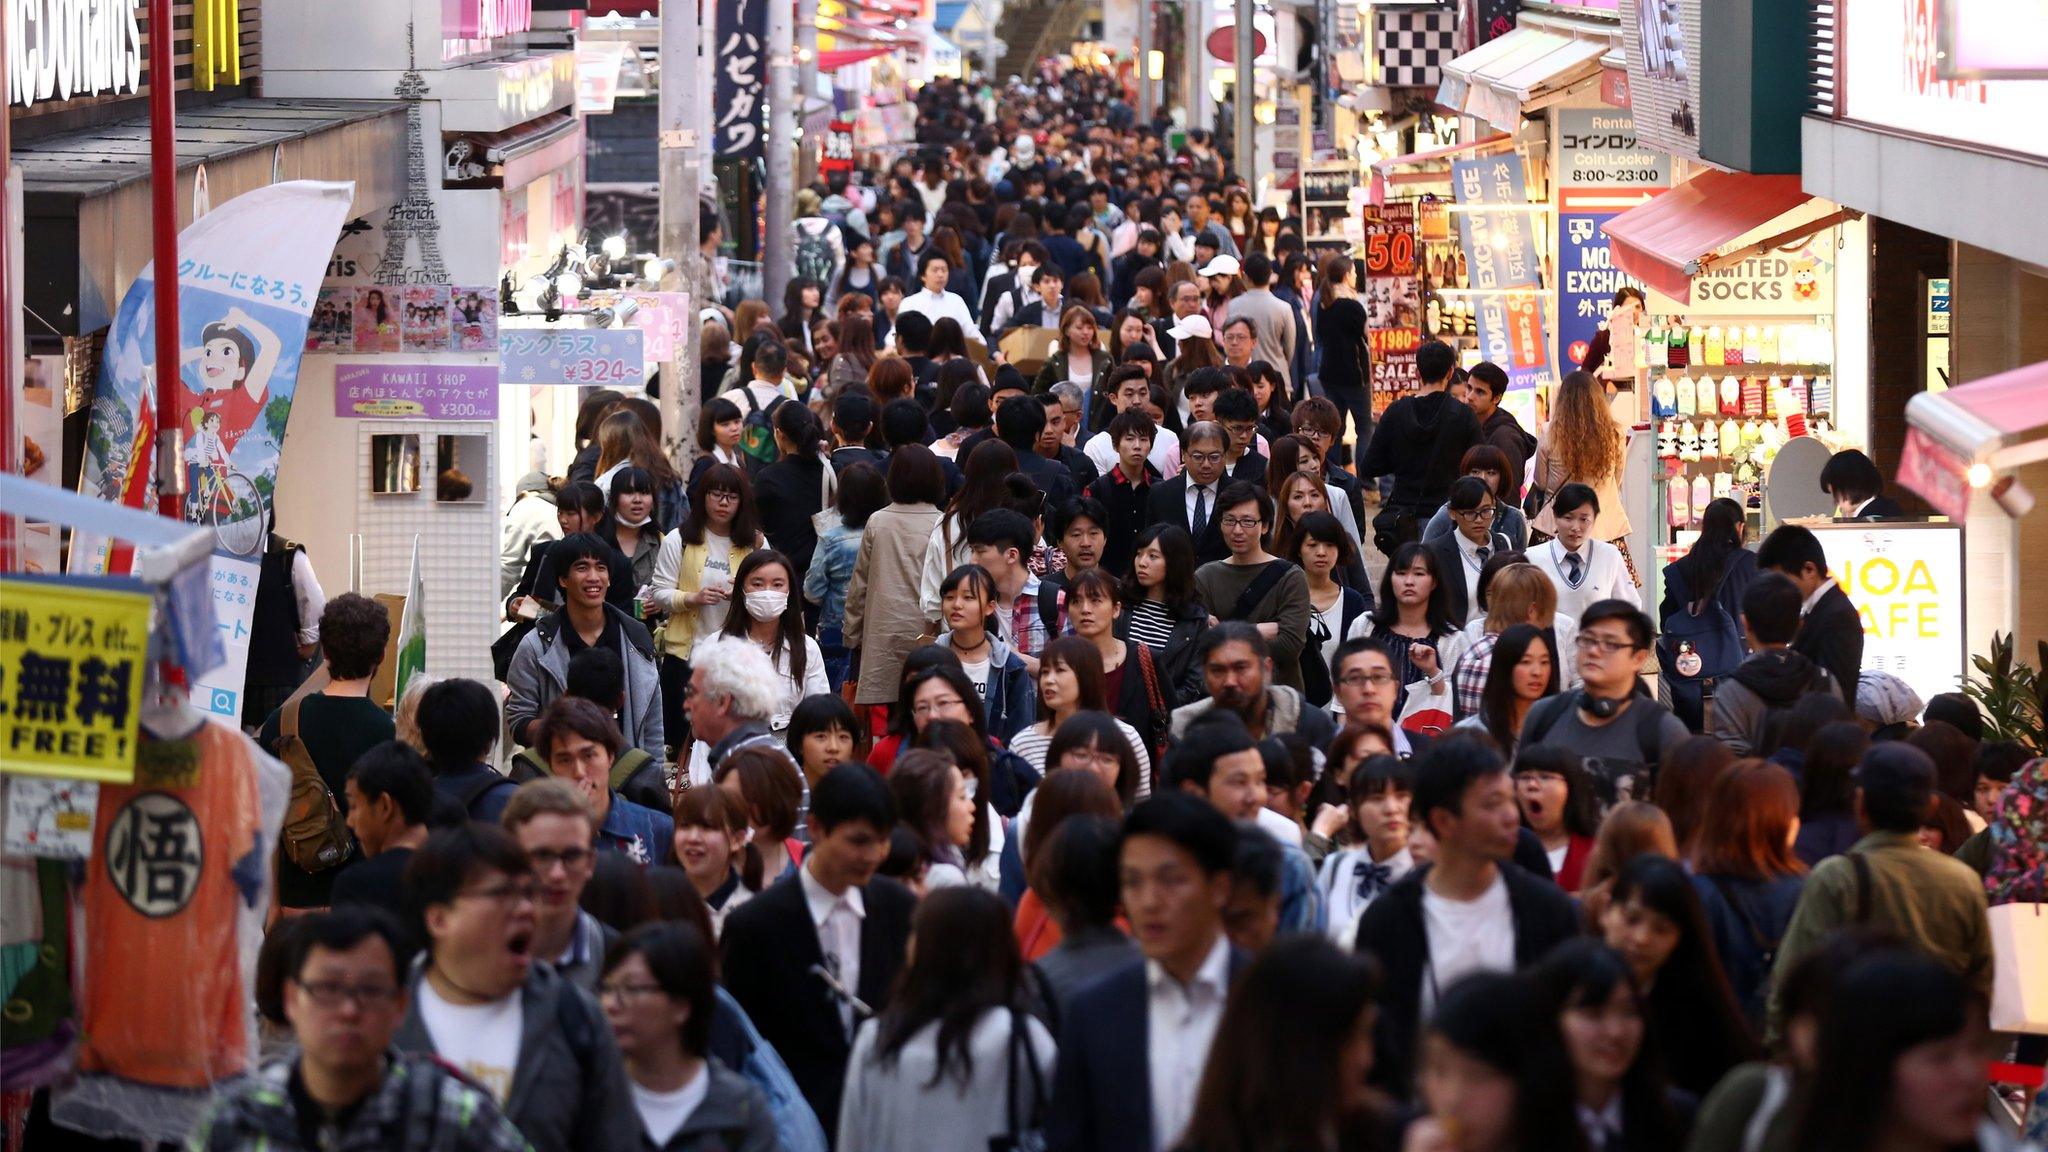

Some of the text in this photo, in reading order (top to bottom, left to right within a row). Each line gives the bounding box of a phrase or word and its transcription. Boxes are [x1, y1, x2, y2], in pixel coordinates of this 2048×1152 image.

[1574, 152, 1657, 166] Coin Locker
[389, 205, 436, 220] French
[1367, 232, 1413, 272] 50
[374, 266, 452, 286] Eiffel Tower
[1697, 281, 1783, 301] SOCKS
[383, 372, 467, 386] KAWAII SHOP
[1374, 363, 1418, 380] SALE
